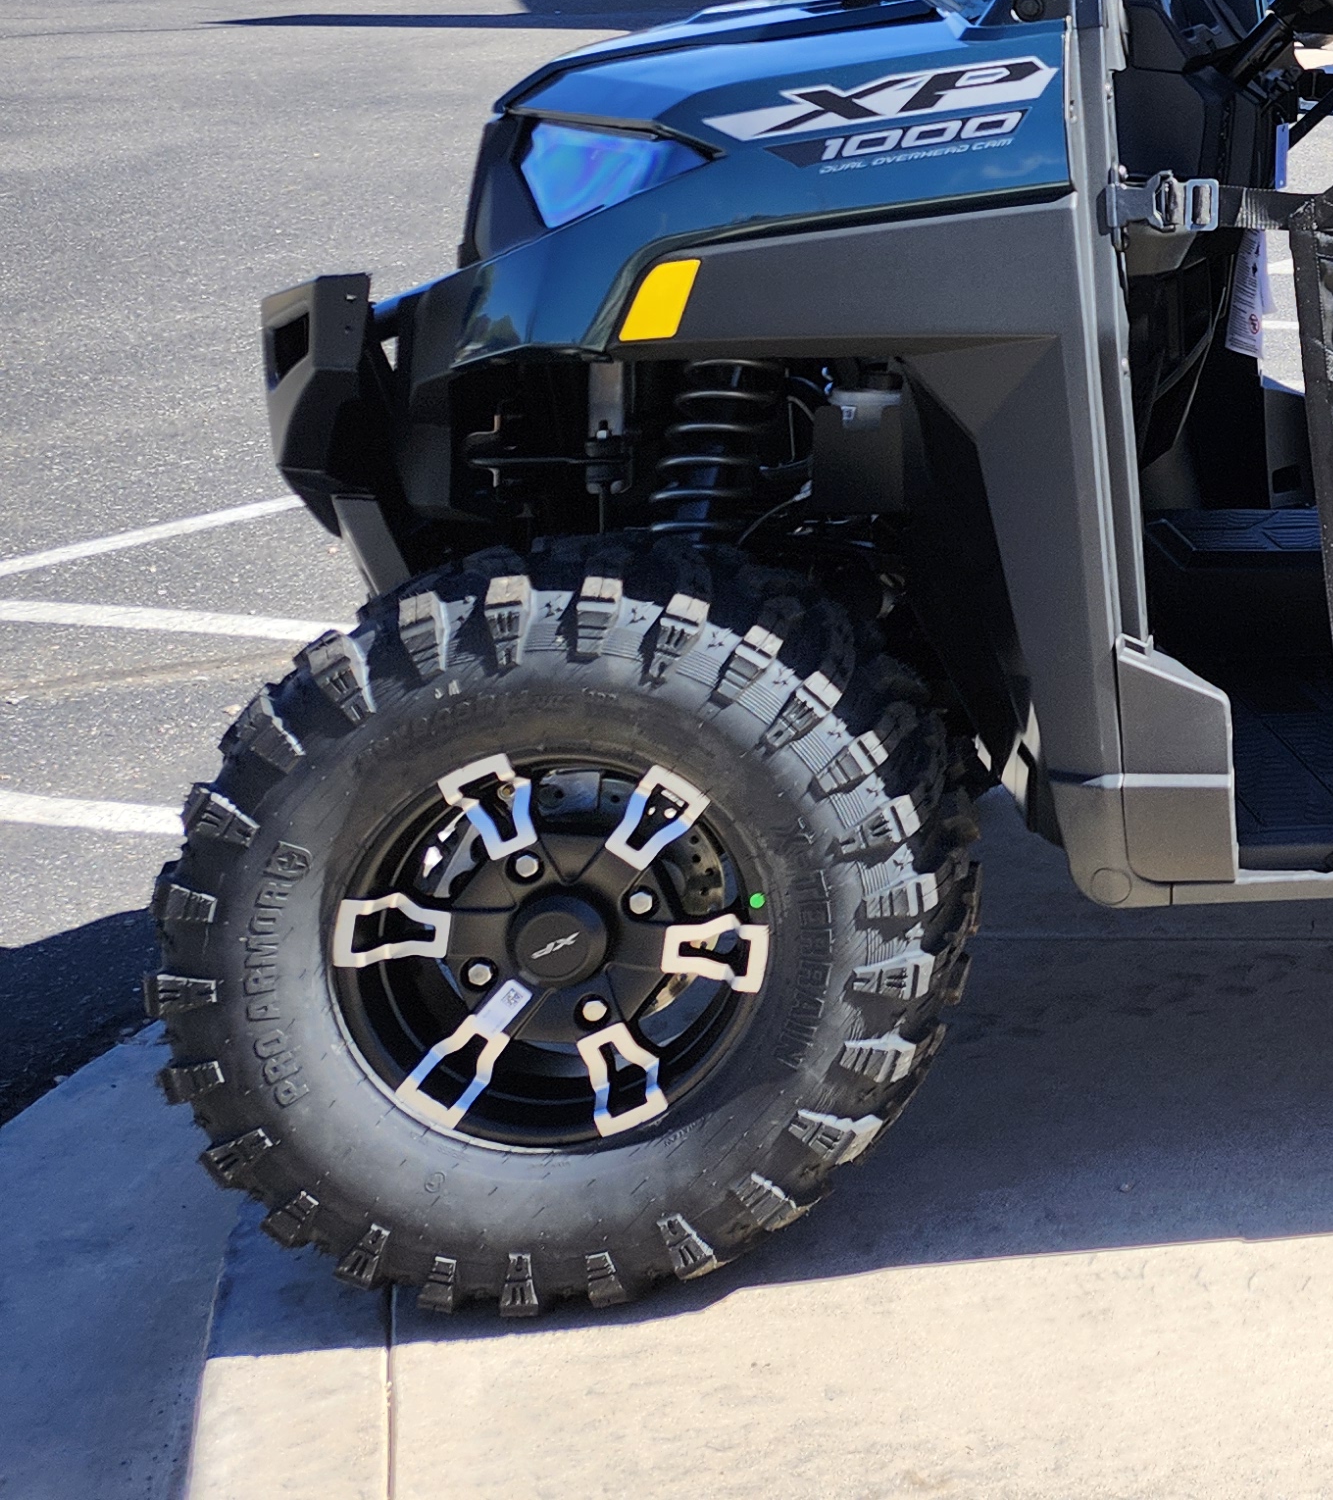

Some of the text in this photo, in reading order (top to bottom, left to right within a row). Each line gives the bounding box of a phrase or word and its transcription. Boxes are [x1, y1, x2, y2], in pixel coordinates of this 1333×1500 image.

[754, 60, 1043, 136] XP
[819, 137, 1014, 174] DUAL OVERHEAD CAM
[820, 110, 1024, 161] 1000
